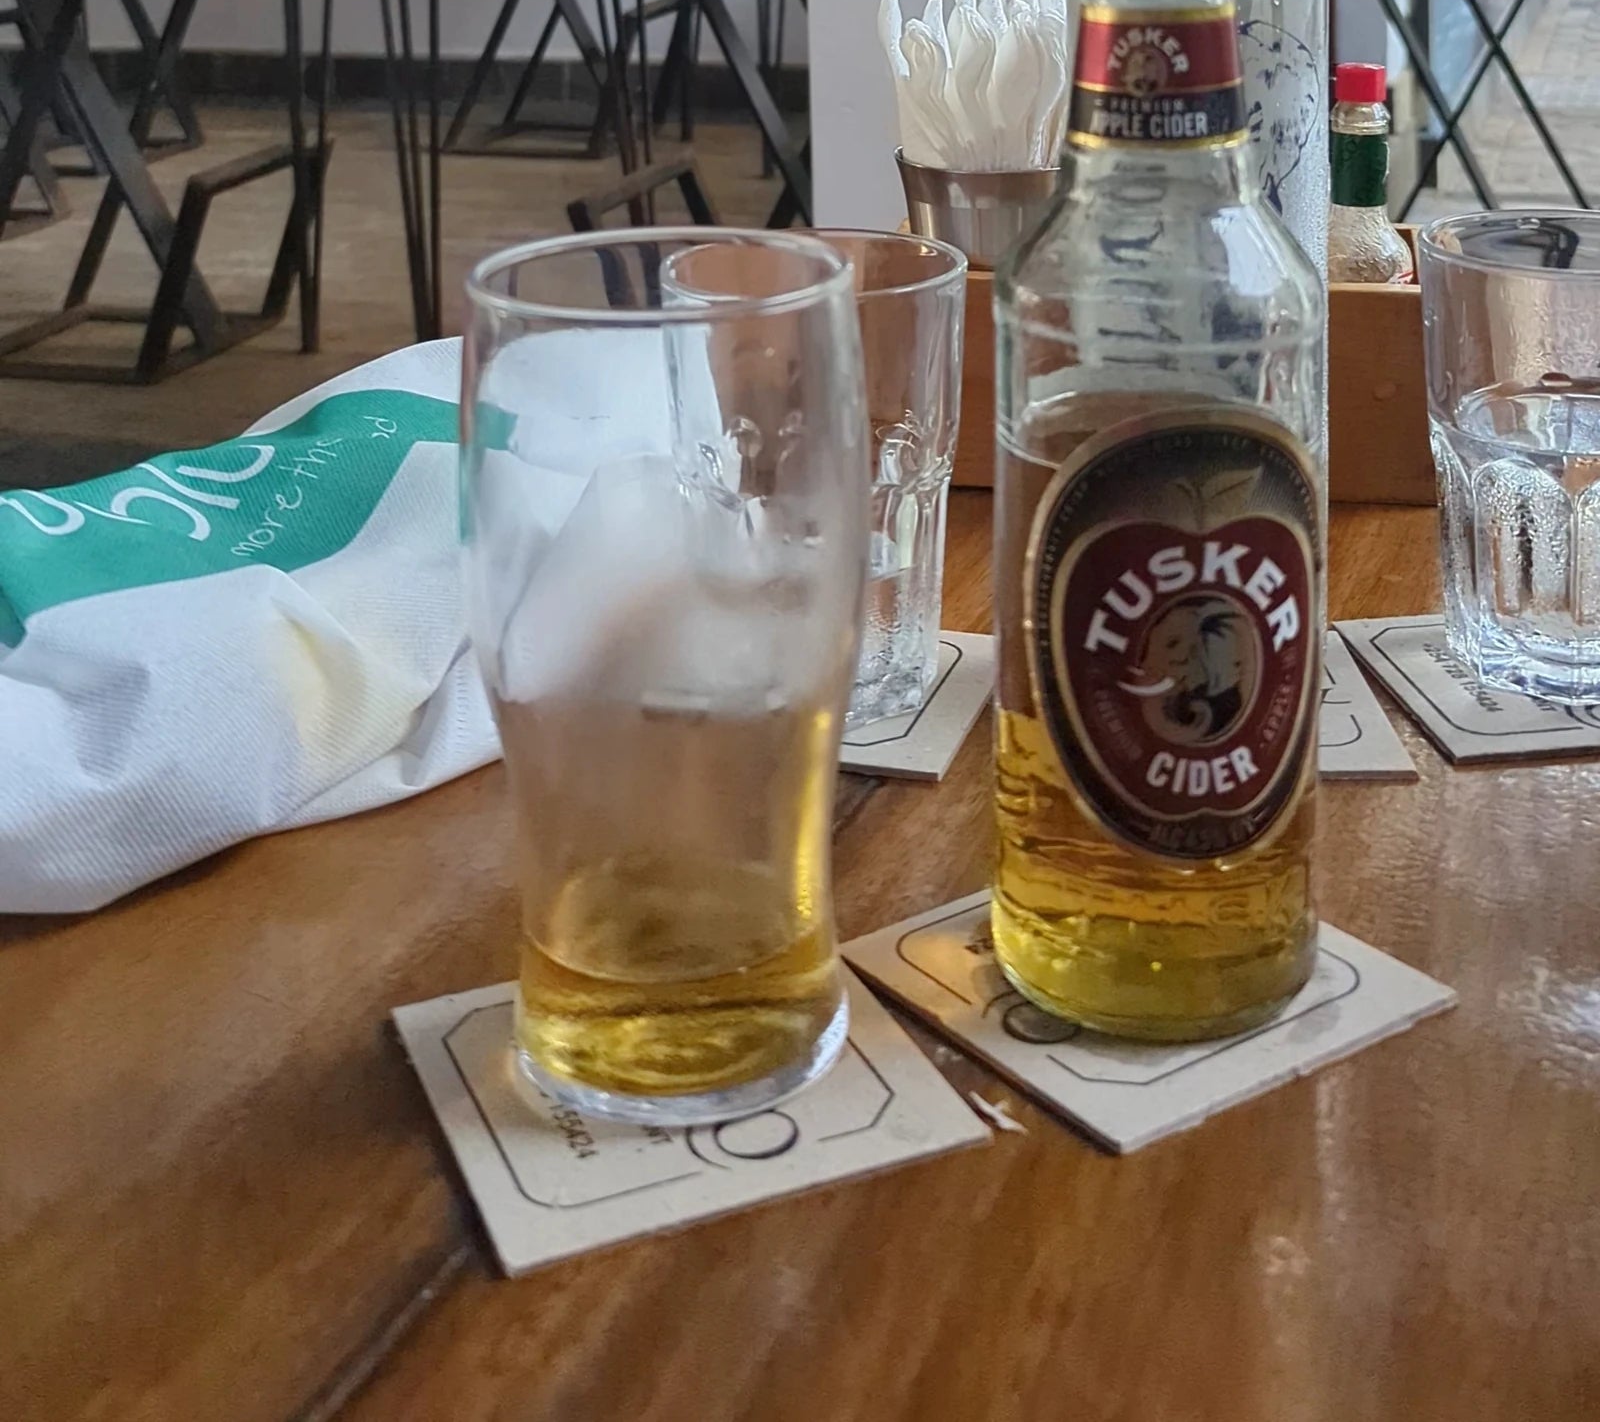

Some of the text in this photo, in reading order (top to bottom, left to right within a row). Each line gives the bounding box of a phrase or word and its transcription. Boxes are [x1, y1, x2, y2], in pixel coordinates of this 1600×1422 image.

[1106, 26, 1191, 74] TUSKER
[1151, 111, 1209, 138] CIDER
[230, 485, 303, 556] more
[1084, 541, 1300, 653] TUSKER
[1146, 745, 1260, 797] CIDER
